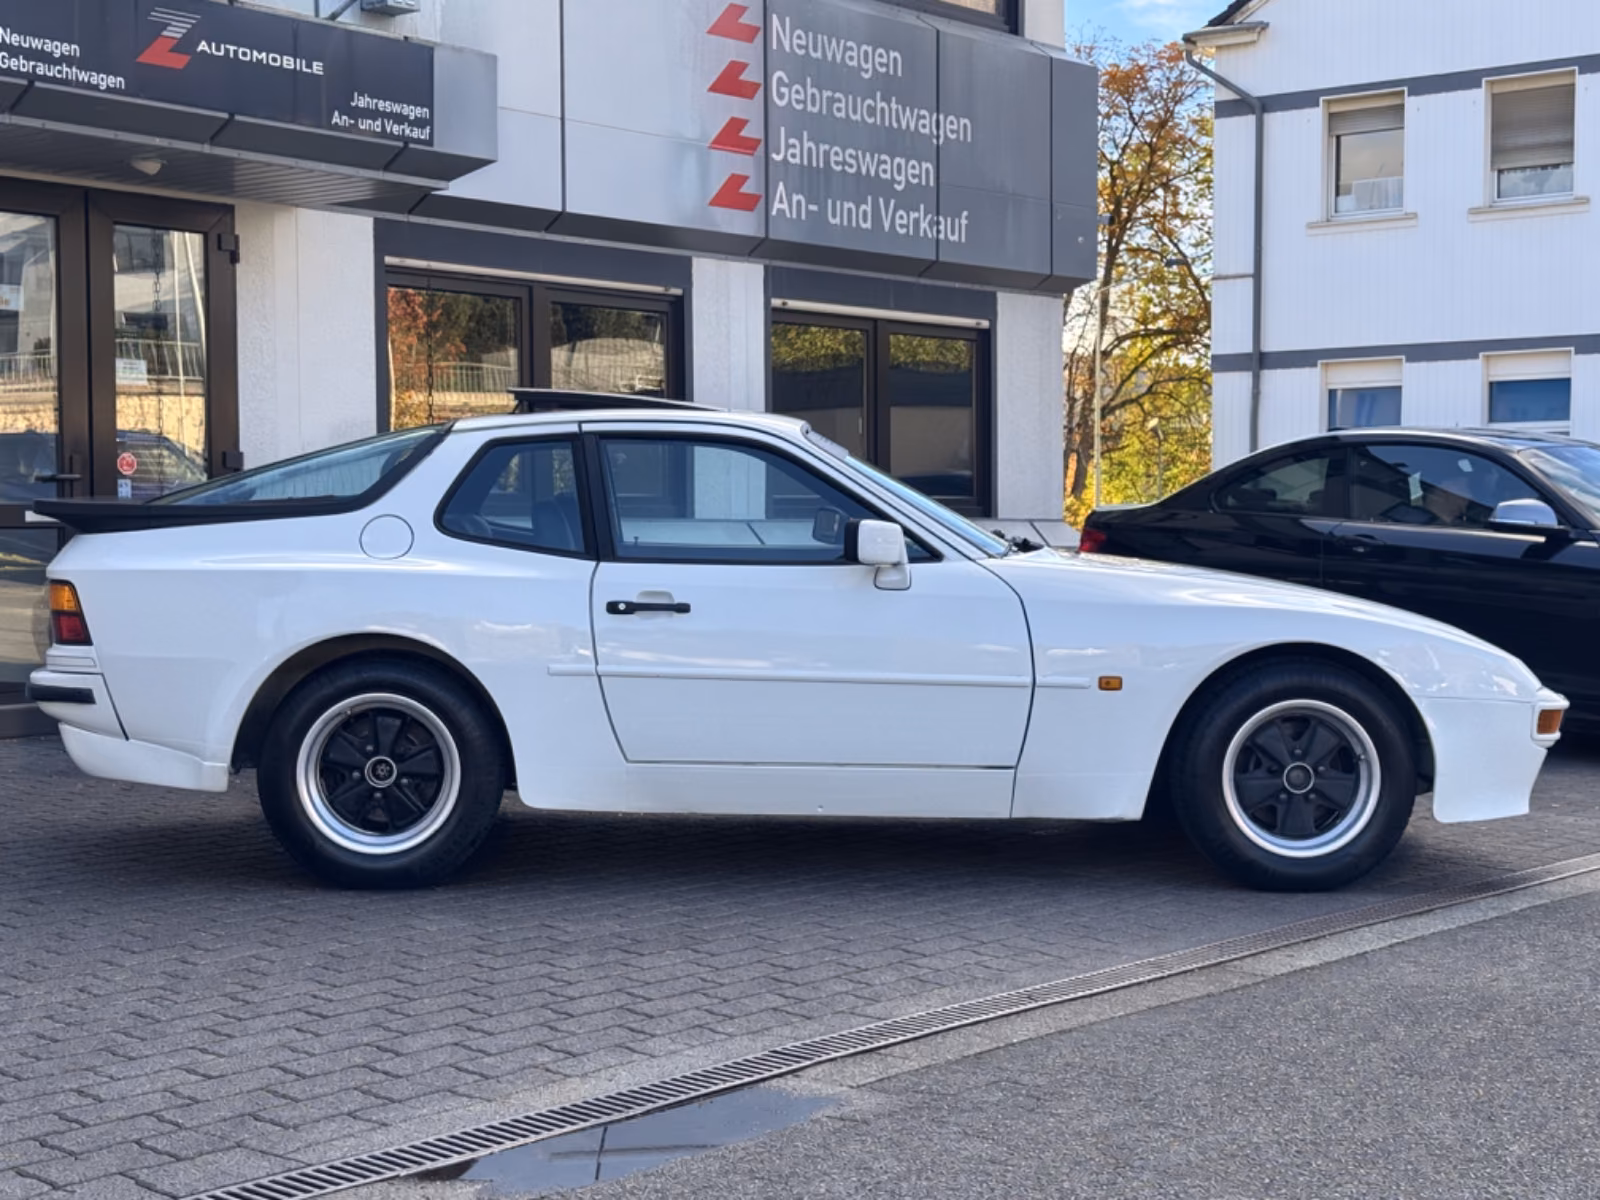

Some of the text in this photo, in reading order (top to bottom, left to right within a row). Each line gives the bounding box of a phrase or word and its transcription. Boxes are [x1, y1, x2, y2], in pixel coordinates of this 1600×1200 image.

[0, 26, 80, 58] Neuwagen
[196, 40, 324, 75] AUTOMOBILE
[772, 14, 902, 79] Neuwagen
[0, 51, 125, 90] Gebrauchtwagen
[331, 109, 431, 140] An- und Verkauf
[350, 92, 430, 120] Jahreswagen
[771, 70, 972, 145] Gebrauchtwagen
[771, 126, 934, 191] Jahreswagen
[771, 181, 969, 243] An- und Verkauf
